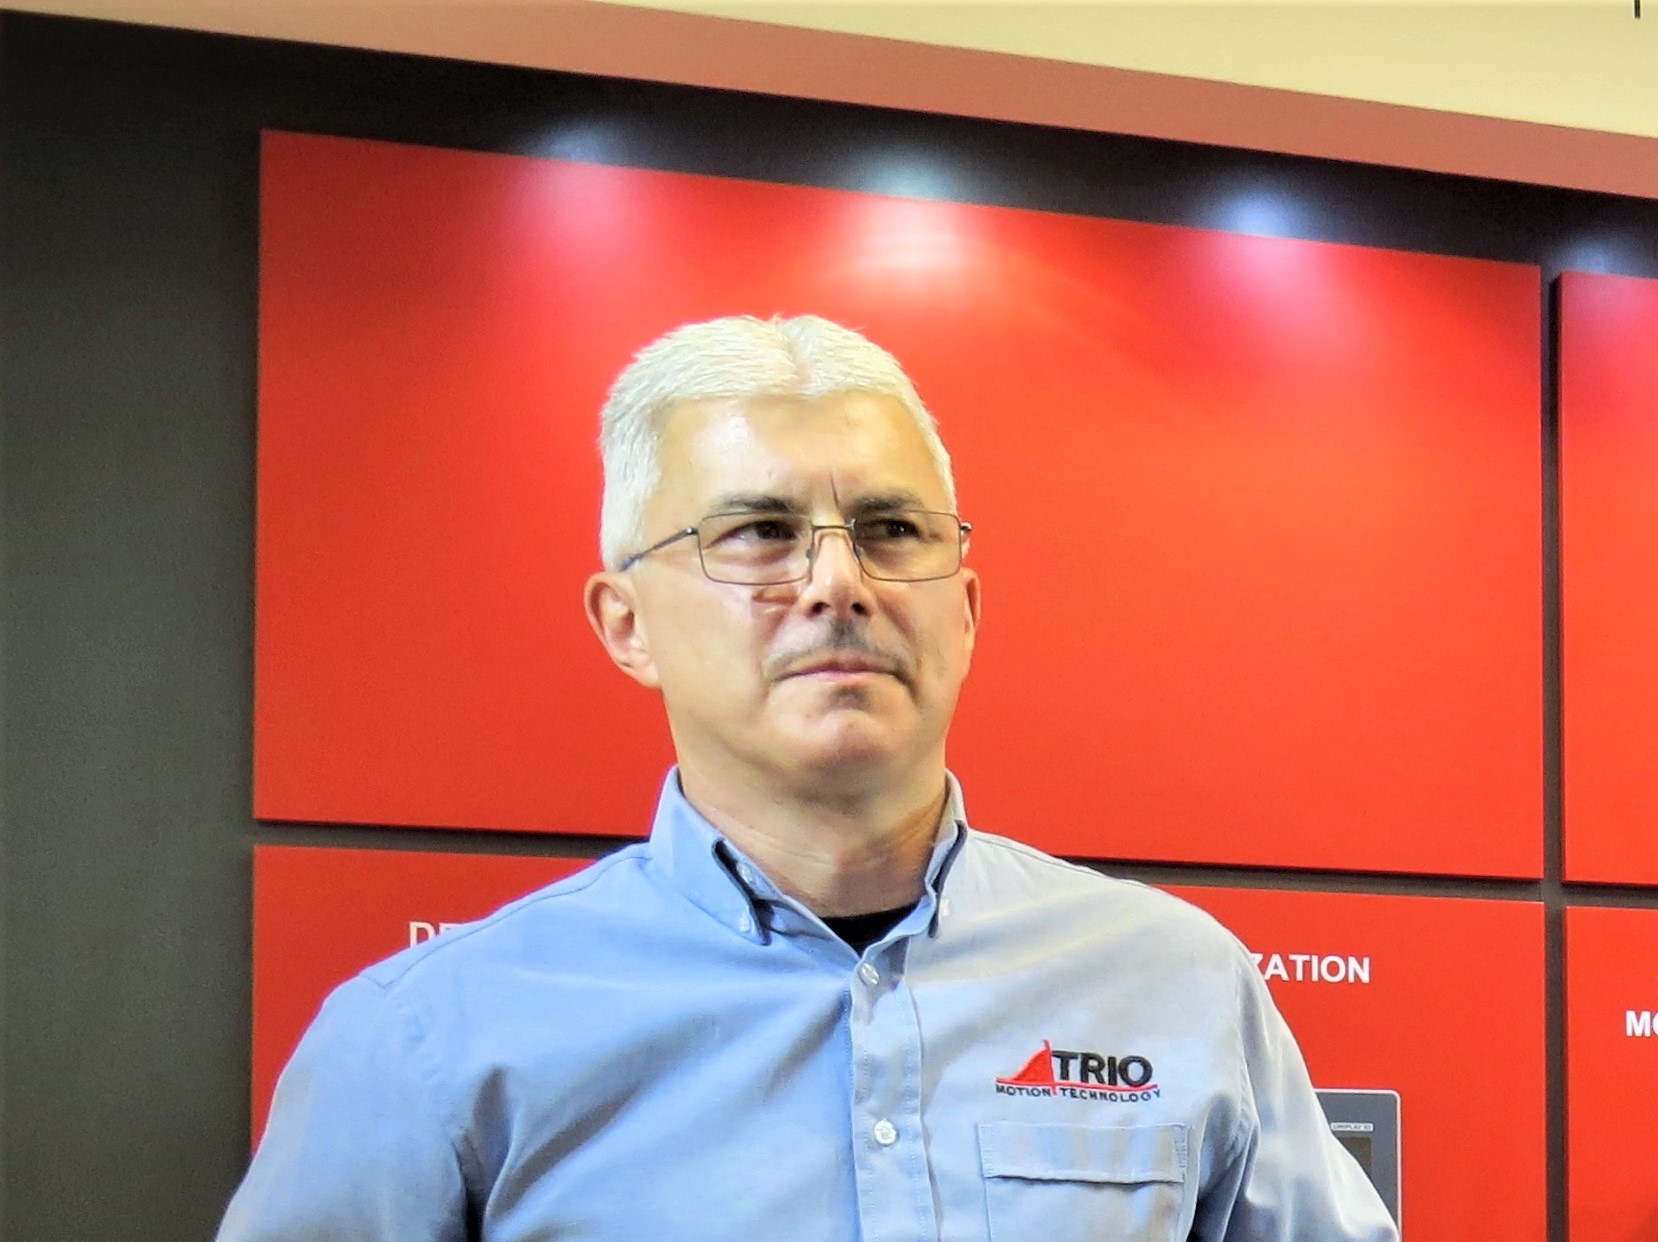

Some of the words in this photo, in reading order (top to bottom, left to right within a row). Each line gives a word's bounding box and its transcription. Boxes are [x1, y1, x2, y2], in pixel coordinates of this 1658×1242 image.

[1052, 1050, 1153, 1087] TRIO
[995, 1083, 1051, 1097] MOTION
[1060, 1086, 1161, 1102] TECHNOLOGY
